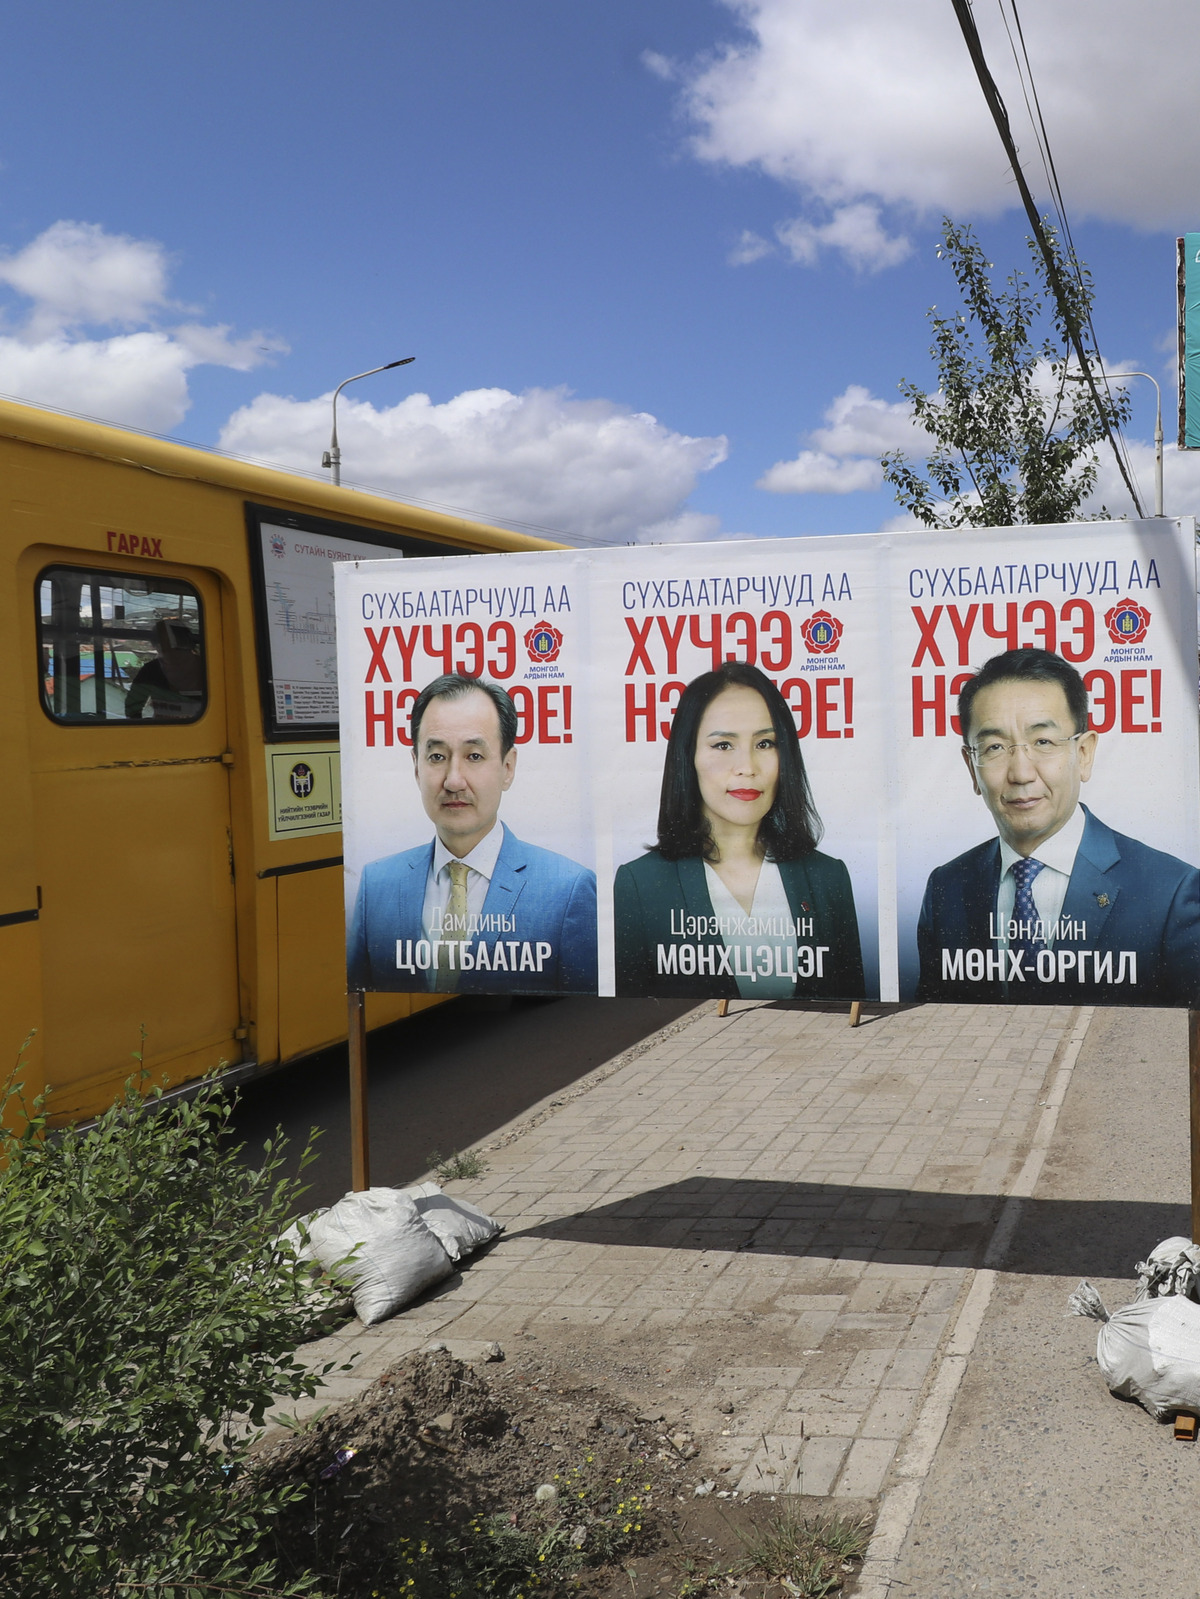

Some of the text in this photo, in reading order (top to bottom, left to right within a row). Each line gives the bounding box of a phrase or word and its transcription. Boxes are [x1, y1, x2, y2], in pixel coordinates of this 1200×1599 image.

[106, 531, 164, 558] ГАРАХ
[294, 543, 326, 557] СУТАЙН
[328, 549, 351, 560] БУЯНТ
[622, 572, 853, 610] СҮХБААТАРЧУУД АА
[908, 558, 1162, 599] СҮХБААТАРЧУУД АА
[362, 584, 572, 620] СҮХБААТАРЧУУД АА
[624, 609, 792, 676] ХҮЧЭЭ
[910, 597, 1096, 668] ХҮЧЭЭ
[364, 620, 517, 684] ХҮЧЭЭ
[529, 665, 559, 673] МОНГОЛ
[800, 663, 846, 672] АРДЫН НАМ
[806, 656, 839, 664] МОНГОЛ
[1103, 654, 1153, 664] АРДЫН НАМ
[1110, 648, 1146, 656] МОНГОЛ
[523, 671, 565, 681] АРДЫН НАМ
[428, 906, 516, 936] Дамдины
[670, 908, 814, 943] Цэрэнжамцын
[988, 910, 1087, 944] Цэндийн
[395, 939, 553, 975] ЦОГТБААТАР
[655, 942, 831, 984] МӨНХЦЭЦЭГ
[940, 946, 1139, 986] МӨНХ-ОРГИЛ
